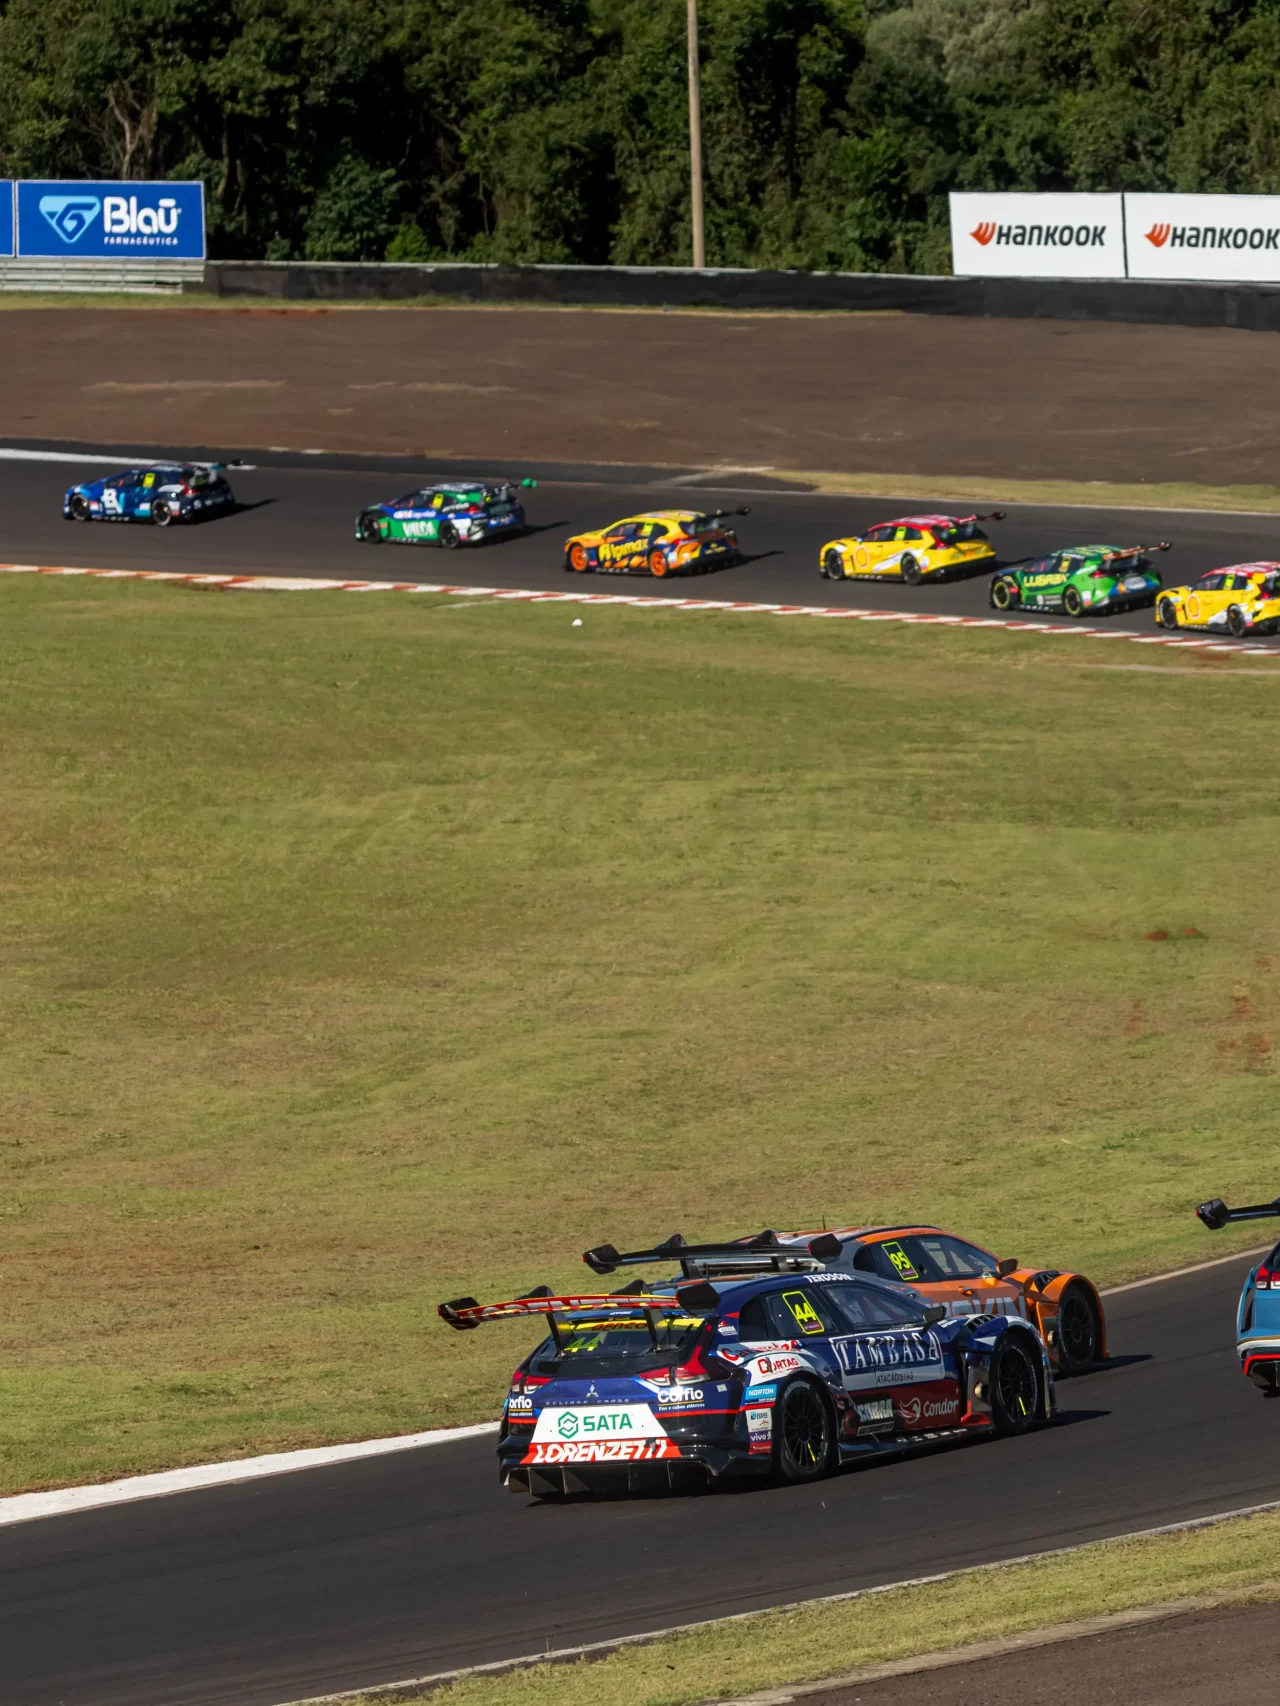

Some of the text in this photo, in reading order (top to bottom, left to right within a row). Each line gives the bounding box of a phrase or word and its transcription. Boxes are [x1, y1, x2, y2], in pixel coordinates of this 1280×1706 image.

[889, 1251, 911, 1270] 95
[803, 1273, 853, 1283] TEROSON
[794, 1302, 817, 1322] 44
[564, 1332, 603, 1352] 44
[836, 1331, 940, 1370] TAMBASA
[657, 1387, 704, 1403] Corfio
[748, 1387, 774, 1397] NORTON
[509, 1396, 532, 1409] orfio
[923, 1399, 959, 1417] Condor
[583, 1413, 633, 1432] SATA
[756, 1411, 768, 1419] BRB
[750, 1433, 766, 1441] vivo
[532, 1440, 667, 1463] LORENZETTI
